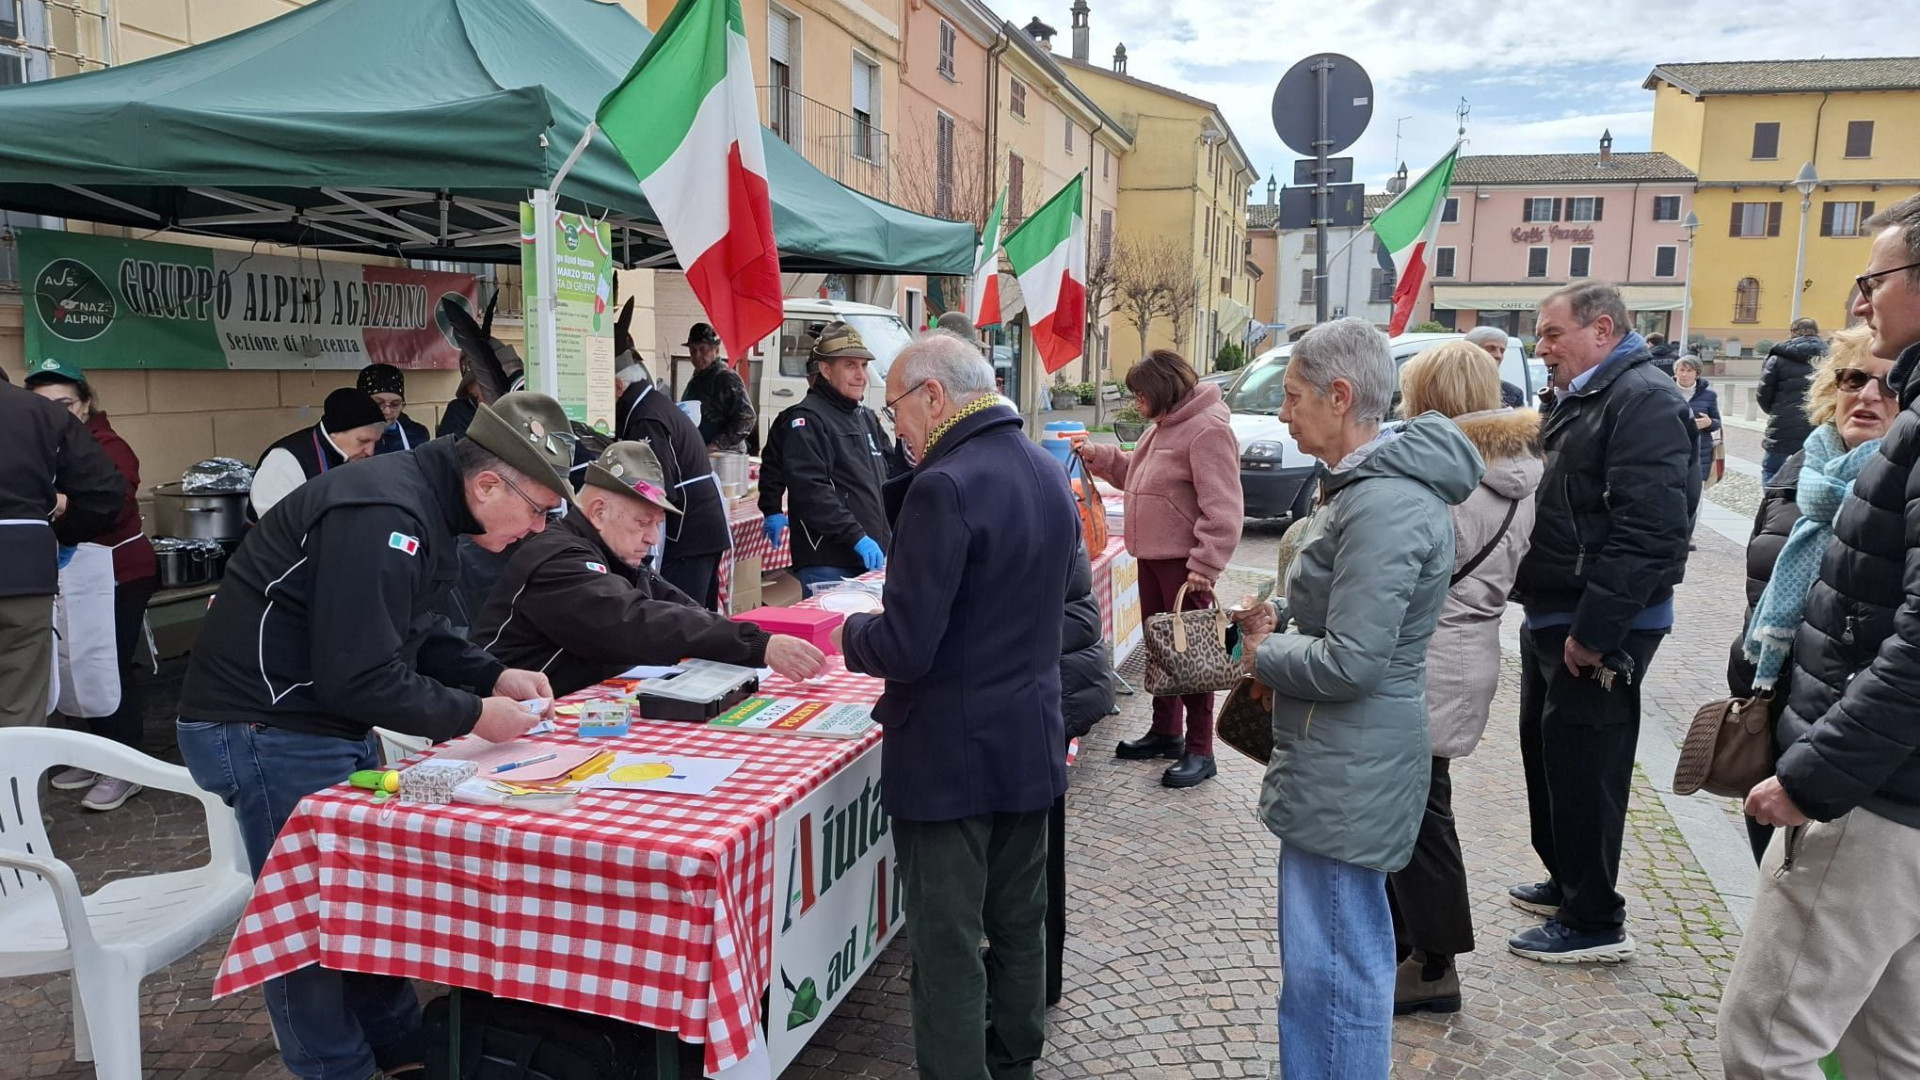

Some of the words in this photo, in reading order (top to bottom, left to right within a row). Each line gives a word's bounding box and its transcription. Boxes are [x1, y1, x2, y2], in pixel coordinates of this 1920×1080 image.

[557, 267, 580, 279] MARZO
[119, 258, 232, 321] GRUPPO
[243, 272, 322, 325] ALPINI
[331, 280, 428, 330] AGAZZANO
[80, 302, 109, 313] NAZ.
[64, 314, 104, 324] ALPINI
[226, 331, 280, 352] Sezione
[283, 335, 299, 352] di
[826, 925, 857, 1001] ad
